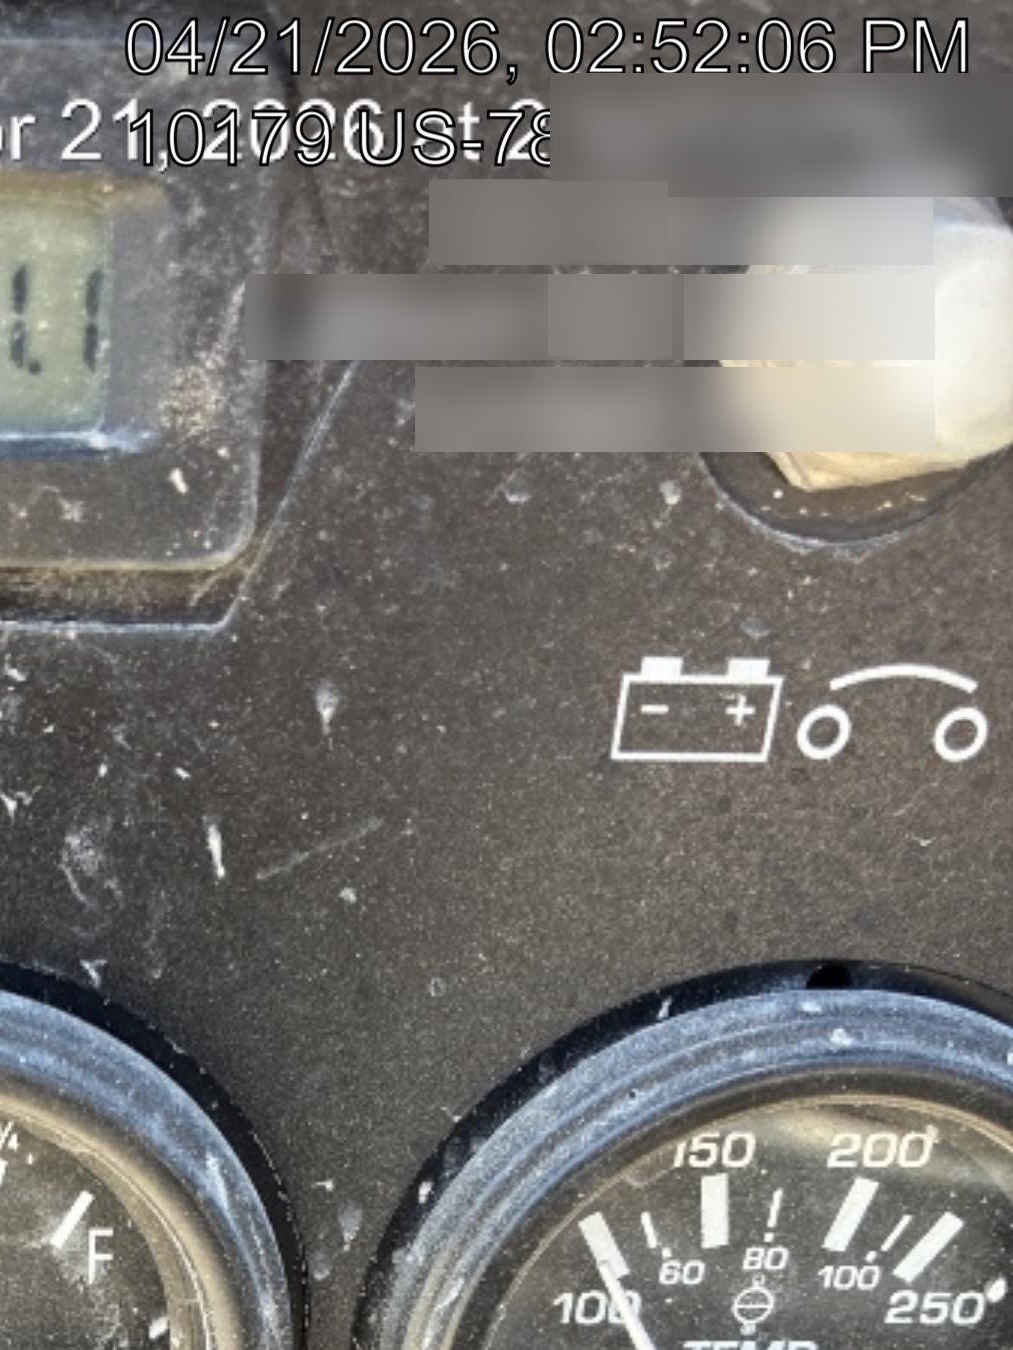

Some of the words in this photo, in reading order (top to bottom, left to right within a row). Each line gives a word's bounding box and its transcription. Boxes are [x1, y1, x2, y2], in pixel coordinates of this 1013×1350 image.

[673, 1131, 756, 1168] 150
[826, 1132, 935, 1169] 200
[86, 1226, 114, 1285] F
[659, 1258, 706, 1286] 60
[742, 1246, 788, 1271] 80
[817, 1264, 882, 1291] 100
[554, 1291, 642, 1325] 100
[883, 1289, 986, 1326] 250
